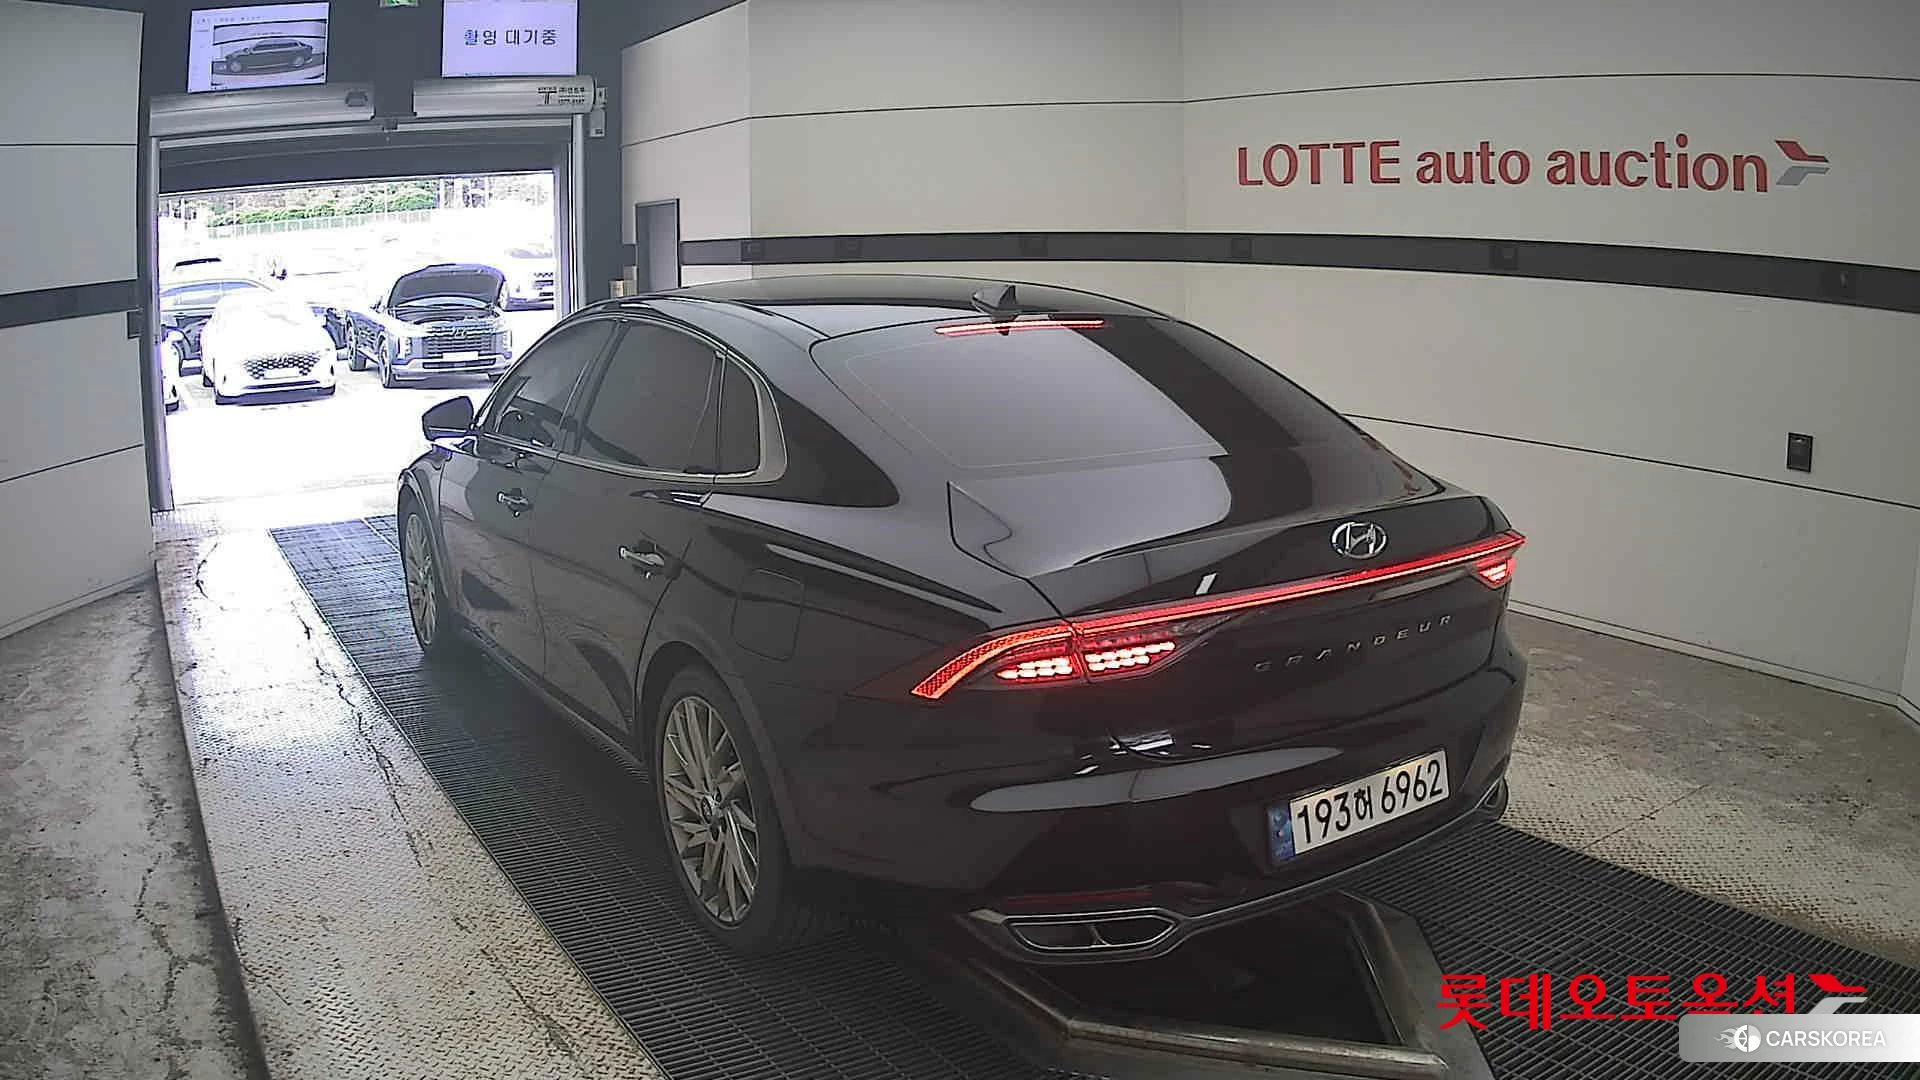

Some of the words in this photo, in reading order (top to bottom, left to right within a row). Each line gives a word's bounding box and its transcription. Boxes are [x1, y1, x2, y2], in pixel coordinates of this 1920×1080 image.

[505, 29, 556, 46] 대기중
[1238, 140, 1400, 187] LOTTE
[1416, 141, 1531, 185] auto
[1546, 133, 1768, 193] auction
[1255, 615, 1451, 671] GRANDEUR
[1381, 759, 1443, 814] 6962
